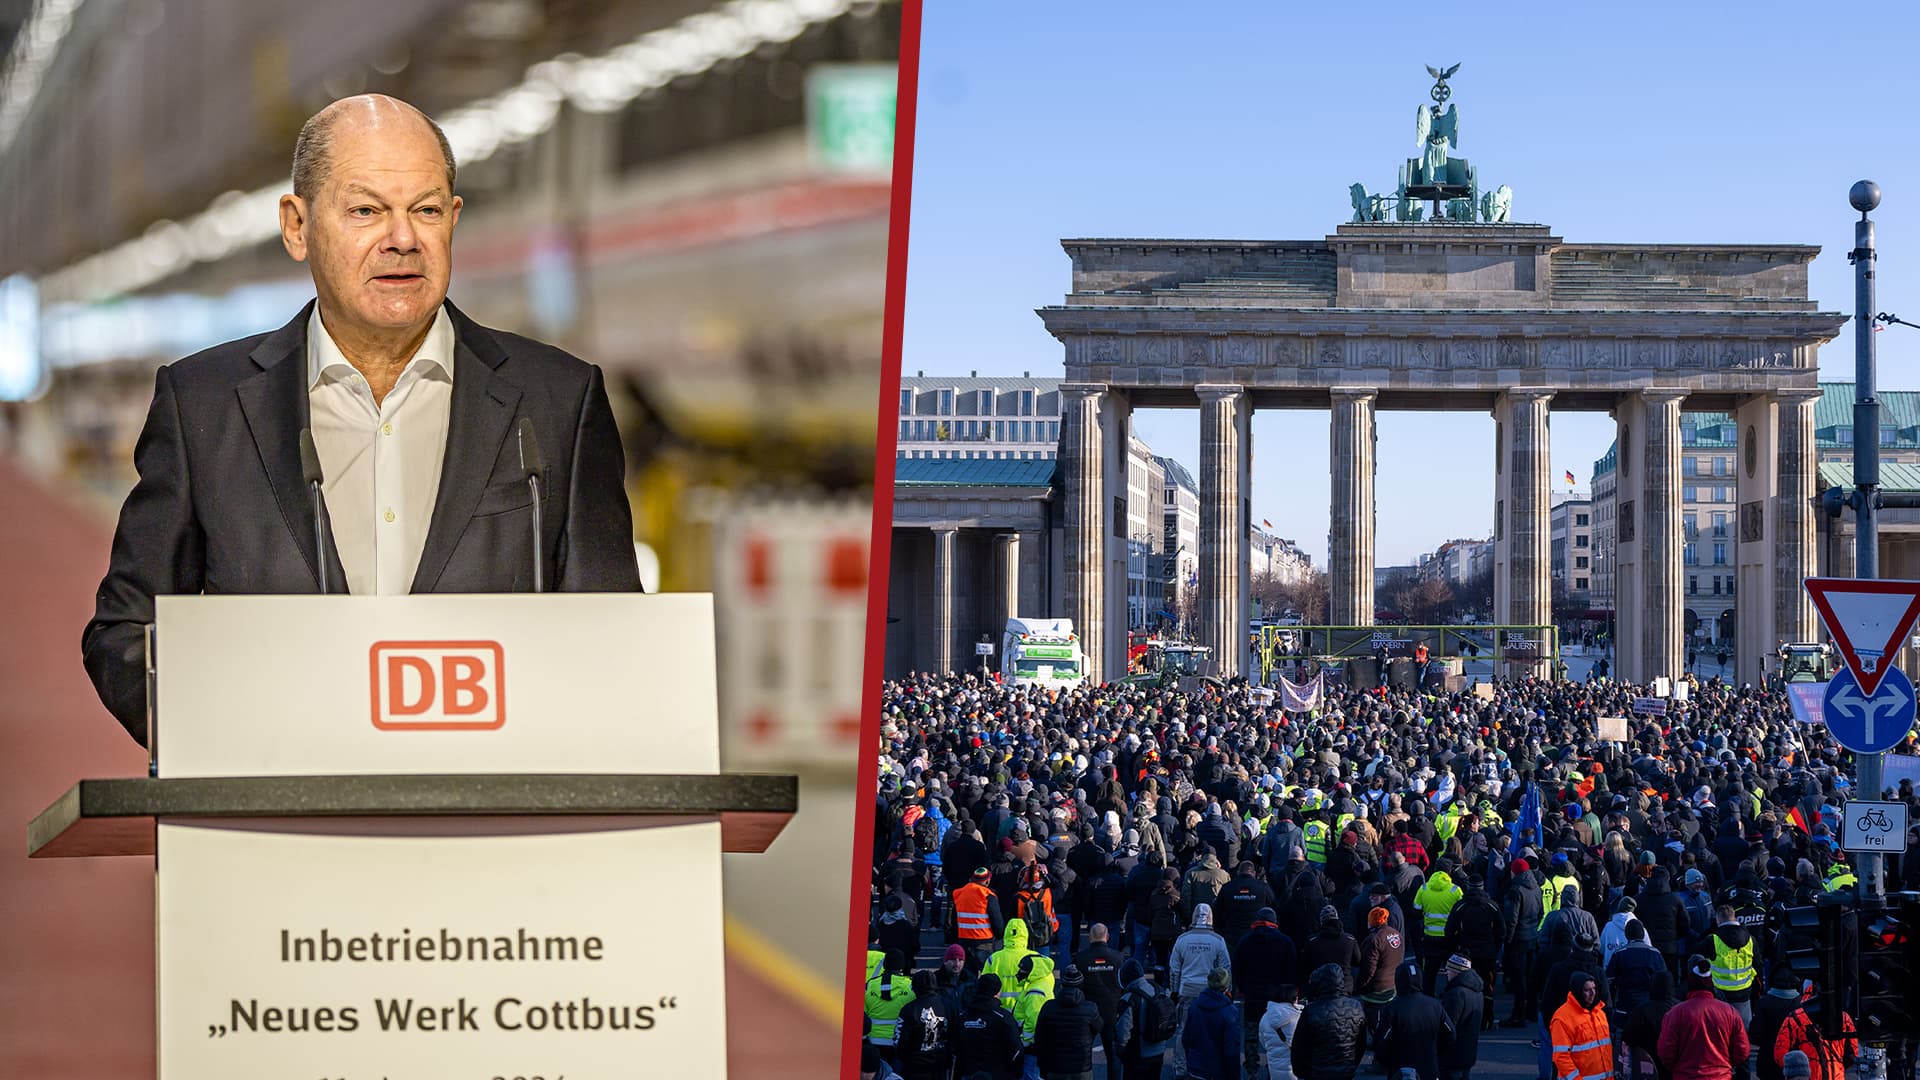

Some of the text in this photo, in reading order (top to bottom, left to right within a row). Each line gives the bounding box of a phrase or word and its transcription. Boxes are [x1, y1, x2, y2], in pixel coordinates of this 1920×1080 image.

[387, 655, 489, 715] DB
[1865, 834, 1885, 846] frei
[281, 928, 604, 962] Inbetriebnahme
[208, 996, 677, 1038] „Neues Werk Cottbus“
